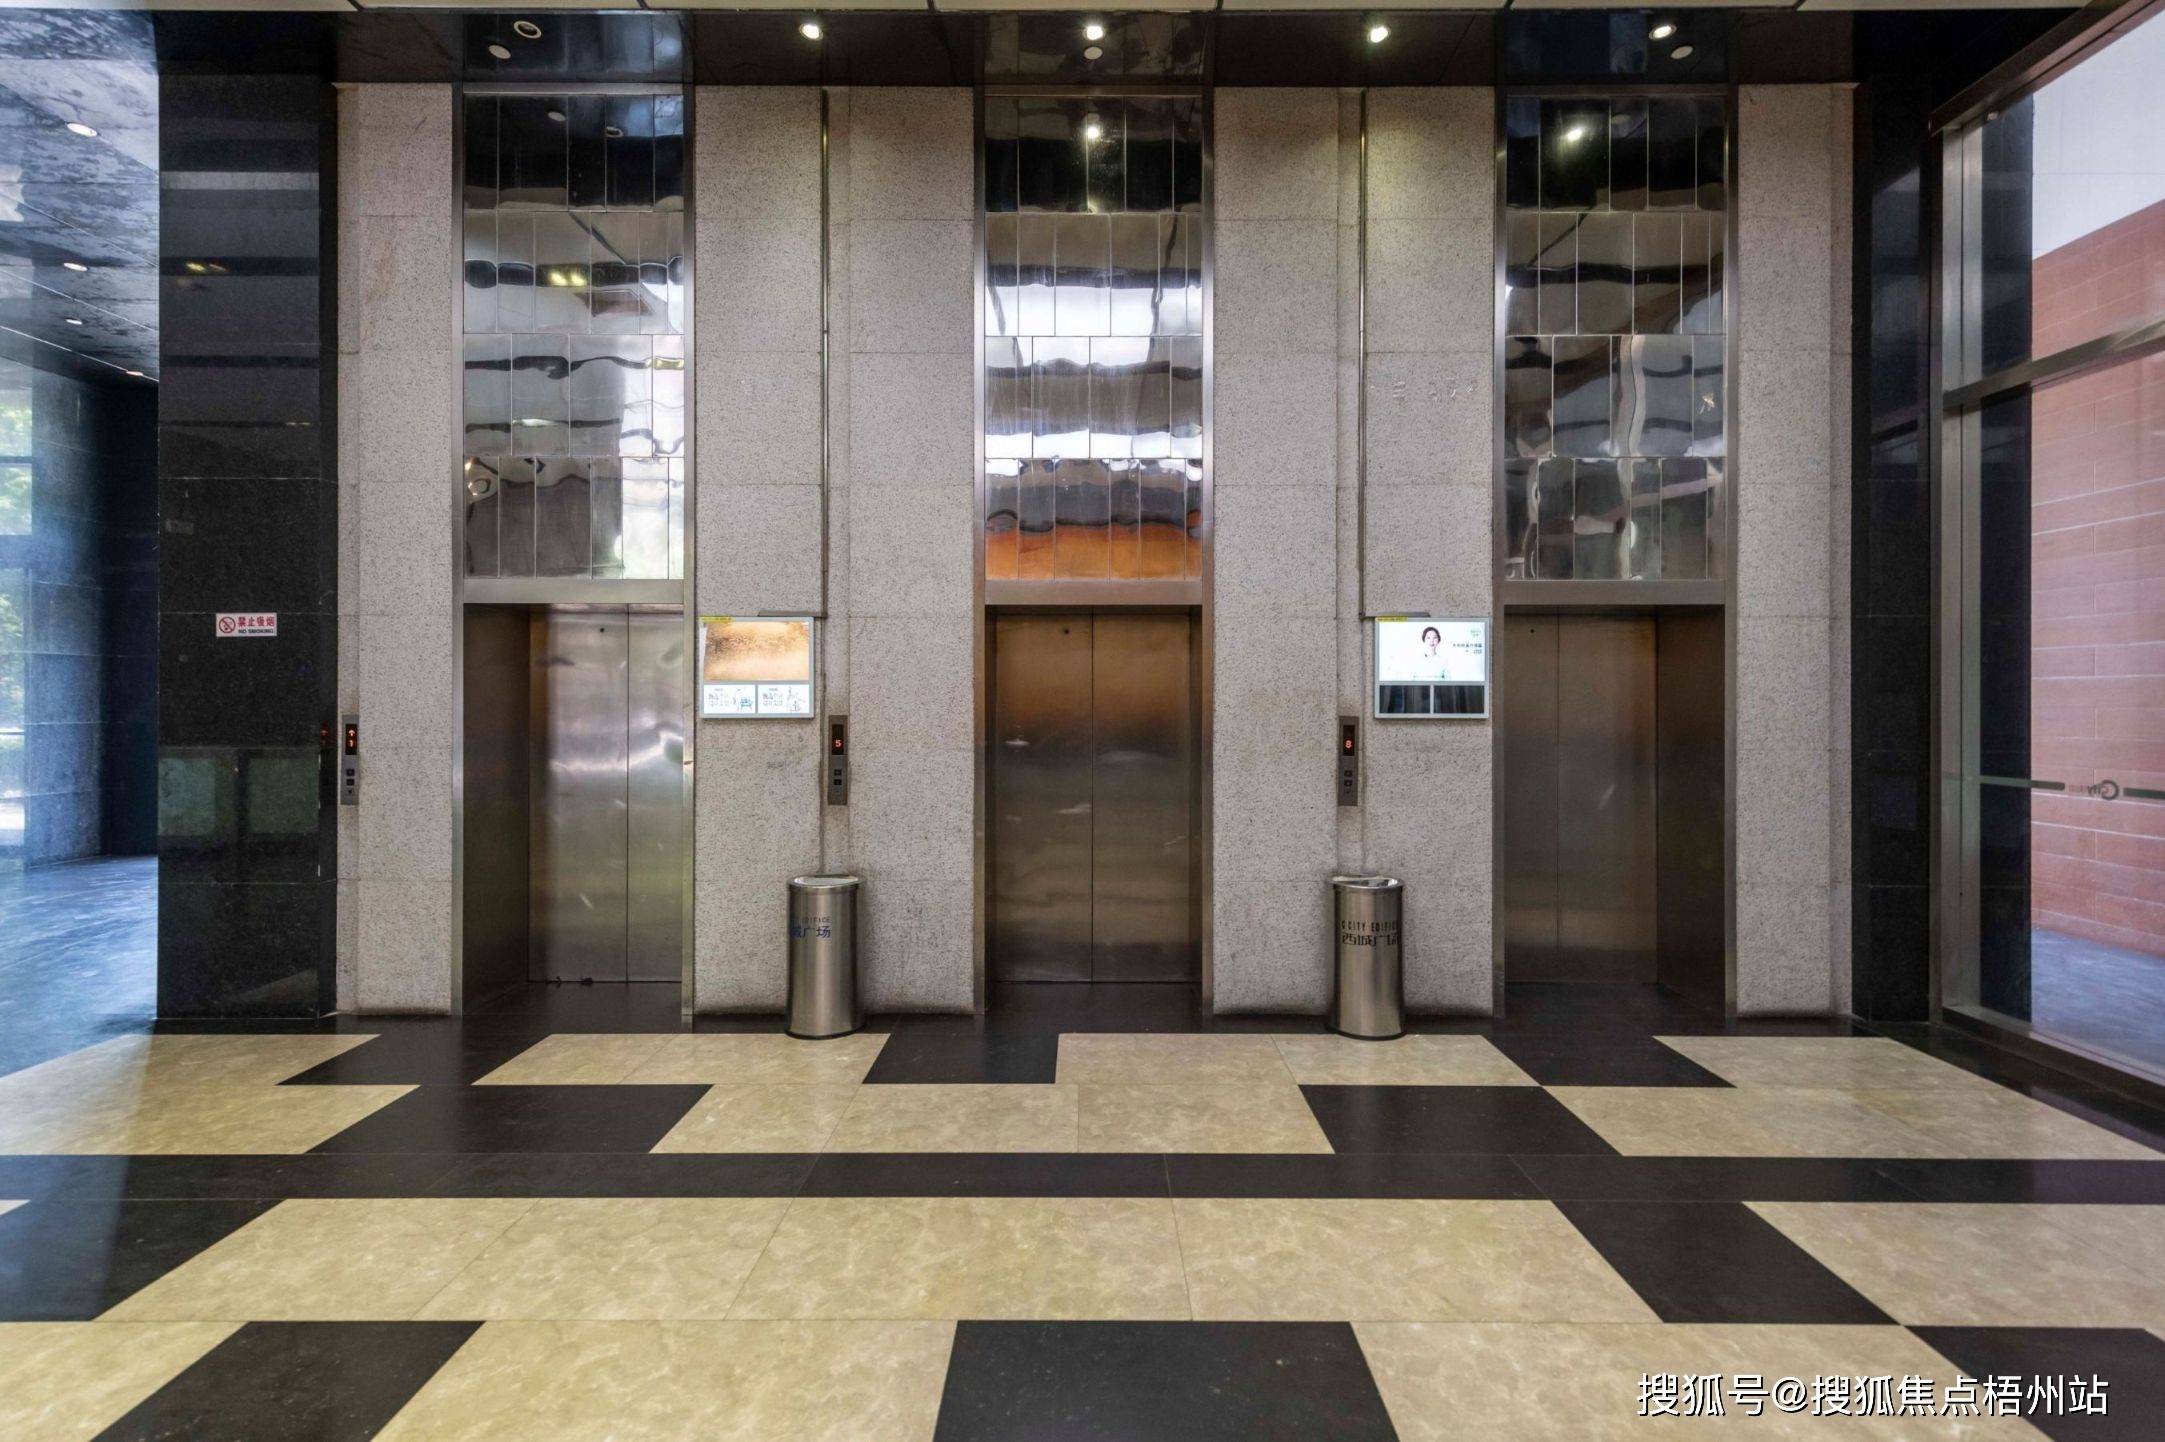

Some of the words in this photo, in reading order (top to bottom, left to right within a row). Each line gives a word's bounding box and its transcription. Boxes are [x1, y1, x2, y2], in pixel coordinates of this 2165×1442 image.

[238, 616, 275, 627] 禁止吸烟
[835, 739, 842, 748] 5
